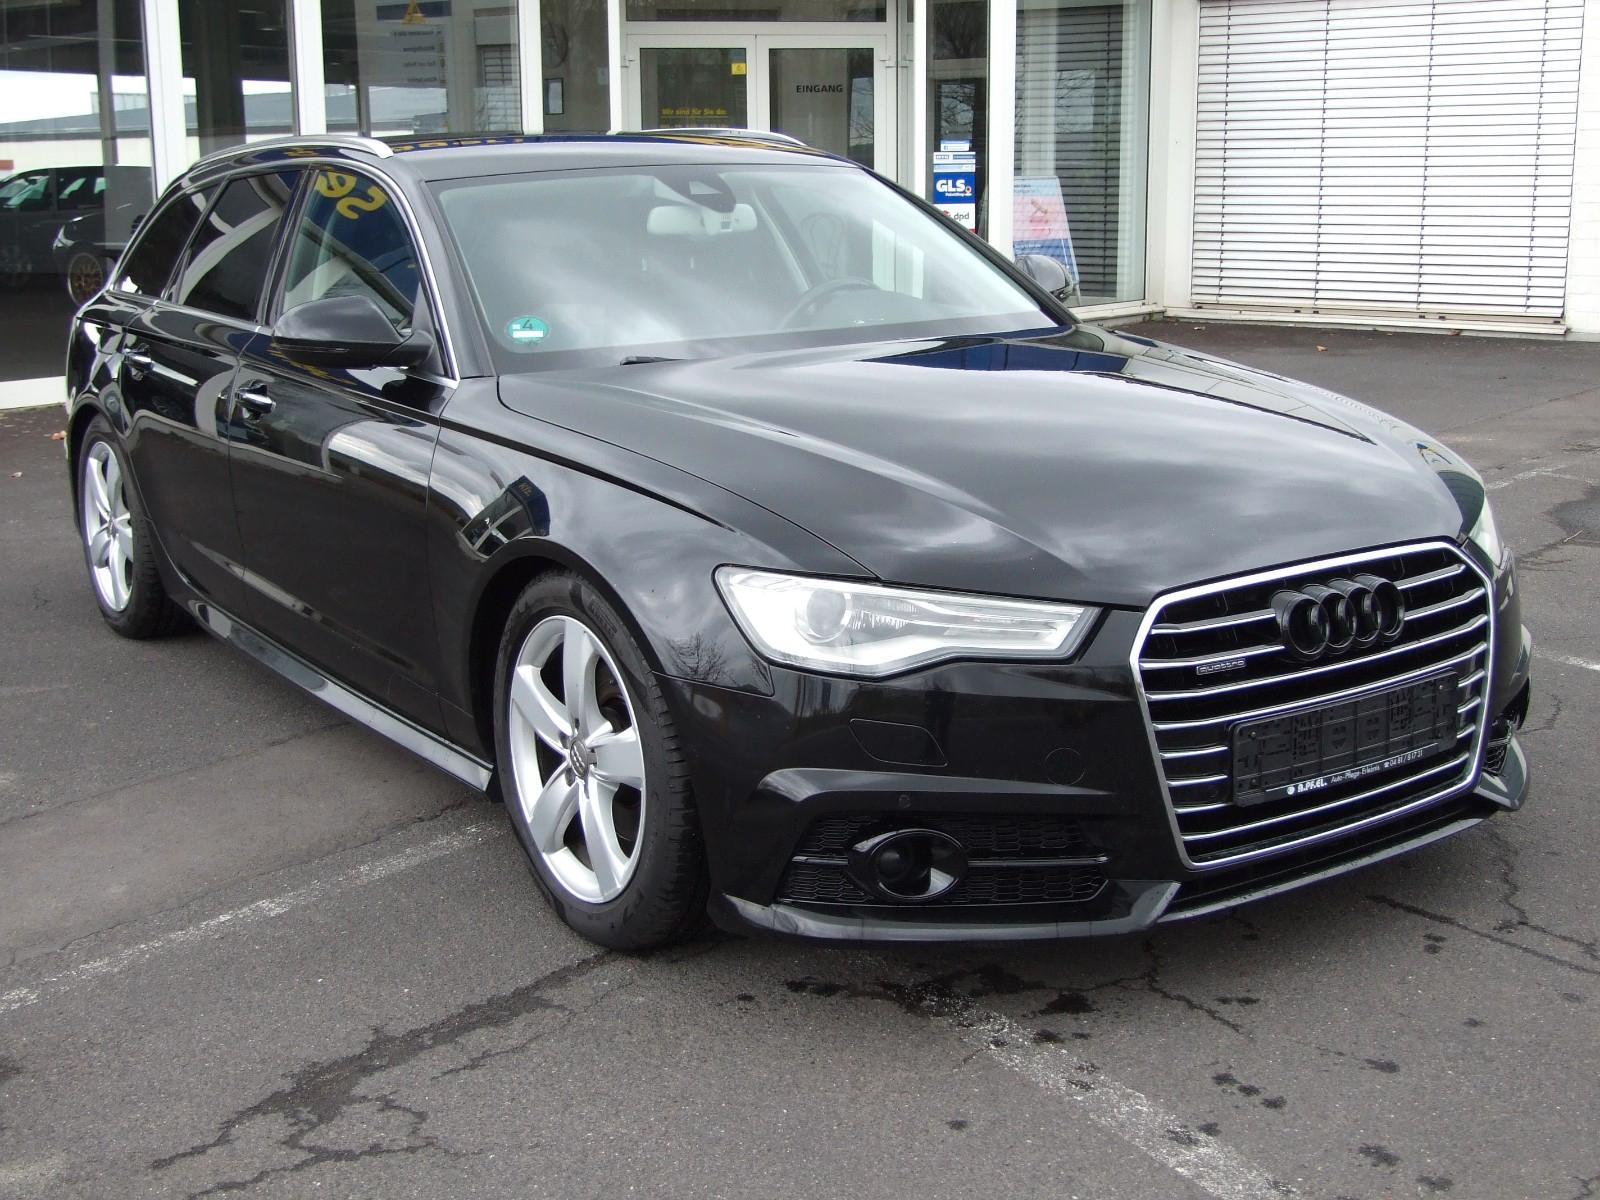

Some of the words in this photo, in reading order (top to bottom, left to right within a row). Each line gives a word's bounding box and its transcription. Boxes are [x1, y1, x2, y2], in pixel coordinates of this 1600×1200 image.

[796, 84, 843, 93] EINGANG
[936, 179, 966, 193] GLS
[953, 212, 970, 222] dpd
[1198, 660, 1245, 674] quattro
